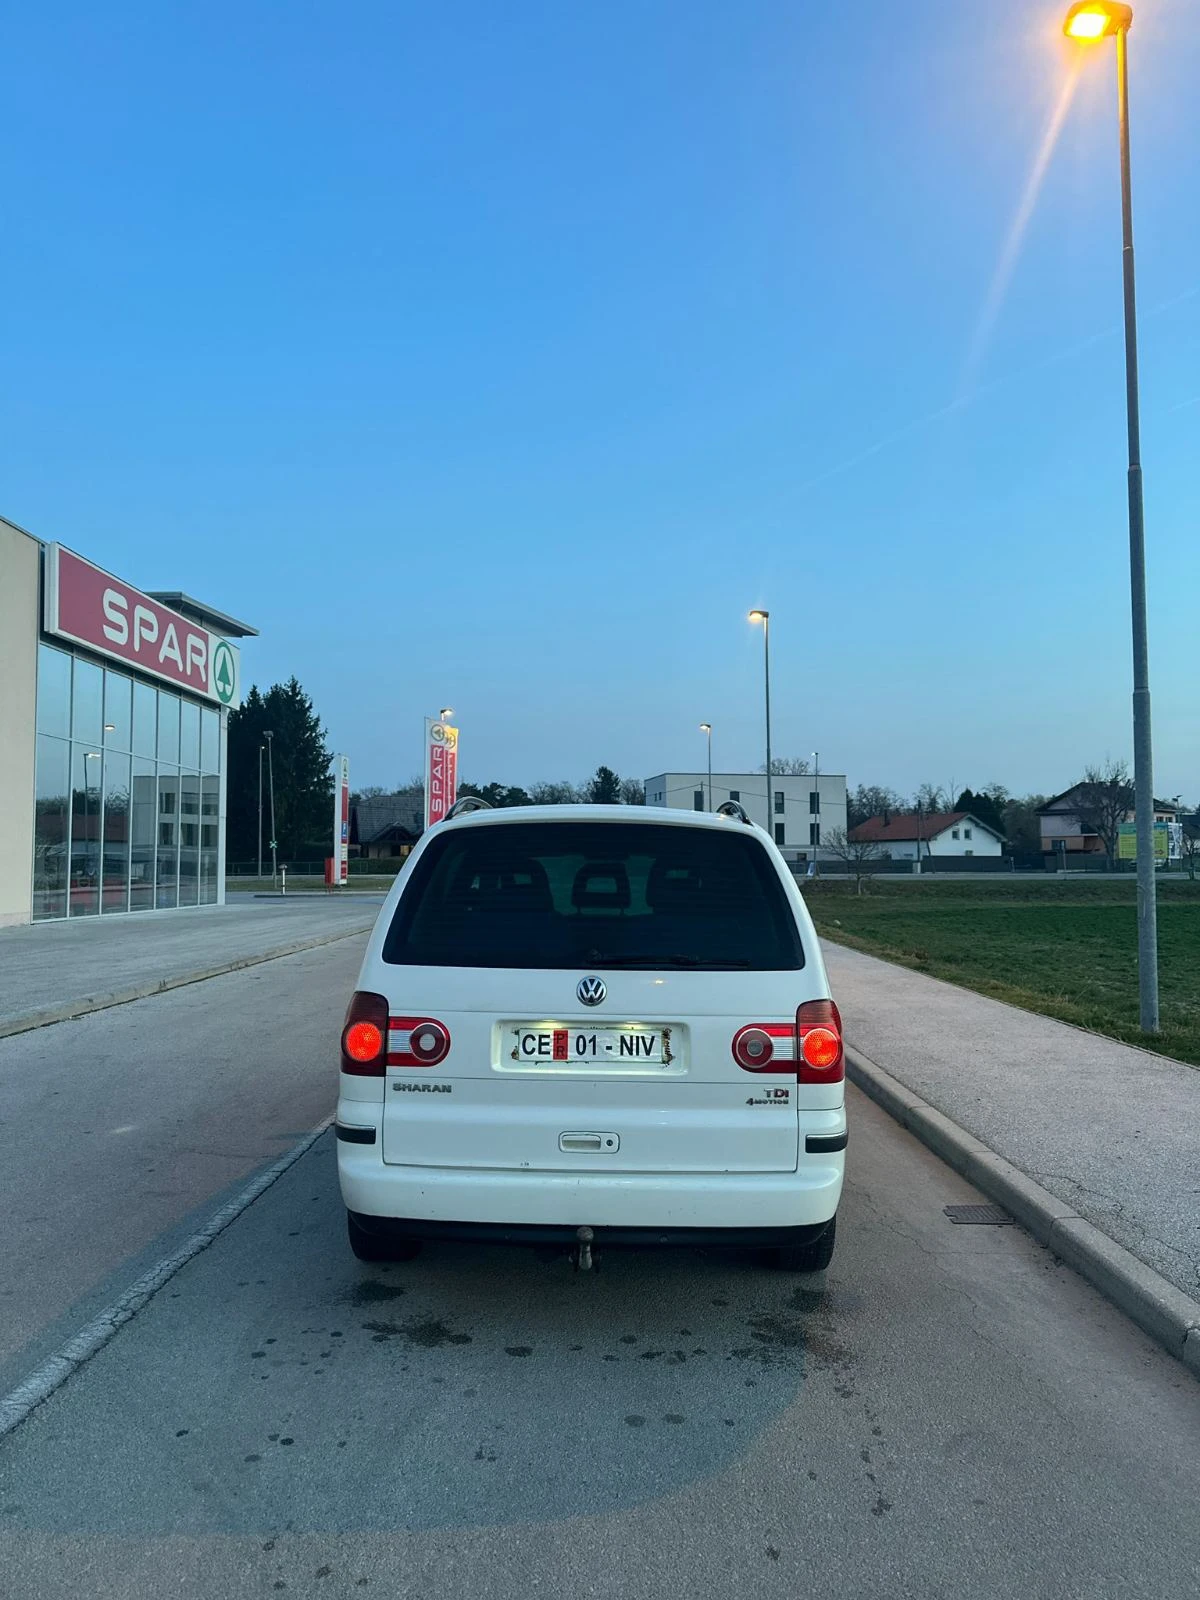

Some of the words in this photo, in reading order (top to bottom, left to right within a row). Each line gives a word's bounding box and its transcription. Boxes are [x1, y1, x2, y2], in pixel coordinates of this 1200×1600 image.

[103, 588, 207, 683] SPAR
[431, 746, 443, 812] SPAR
[522, 1034, 550, 1055] CE
[620, 1035, 656, 1056] NIV
[392, 1082, 452, 1093] SHARAN
